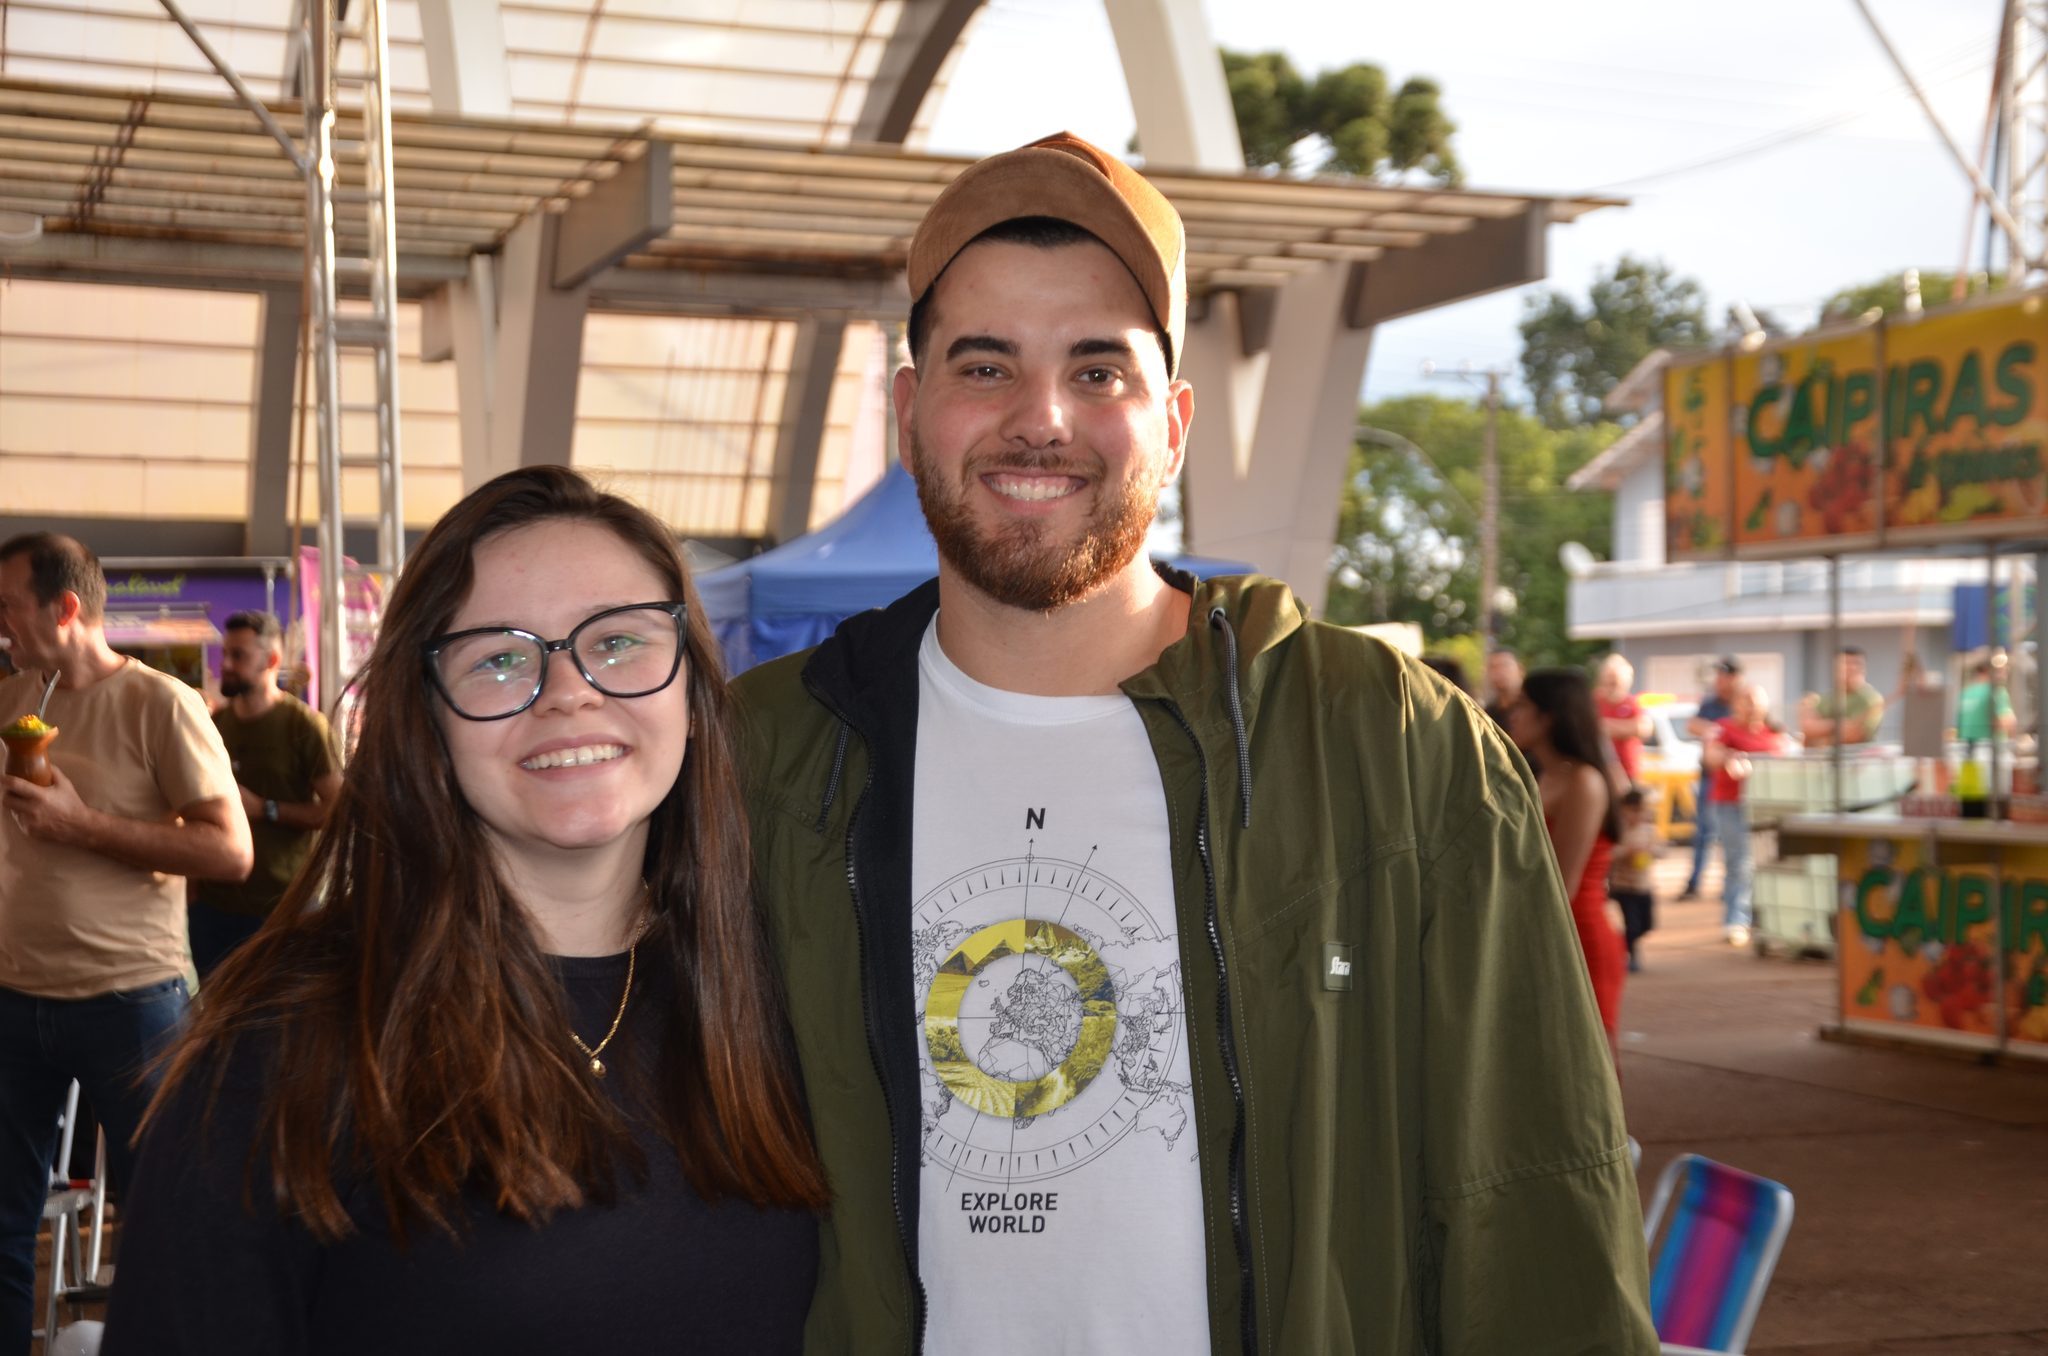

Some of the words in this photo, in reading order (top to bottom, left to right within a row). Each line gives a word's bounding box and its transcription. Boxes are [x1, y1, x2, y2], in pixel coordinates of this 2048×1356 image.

[1748, 339, 2036, 460] CAIPIRAS
[1026, 807, 1046, 830] N
[961, 1192, 1058, 1211] EXPLORE
[968, 1215, 1046, 1234] WORLD
